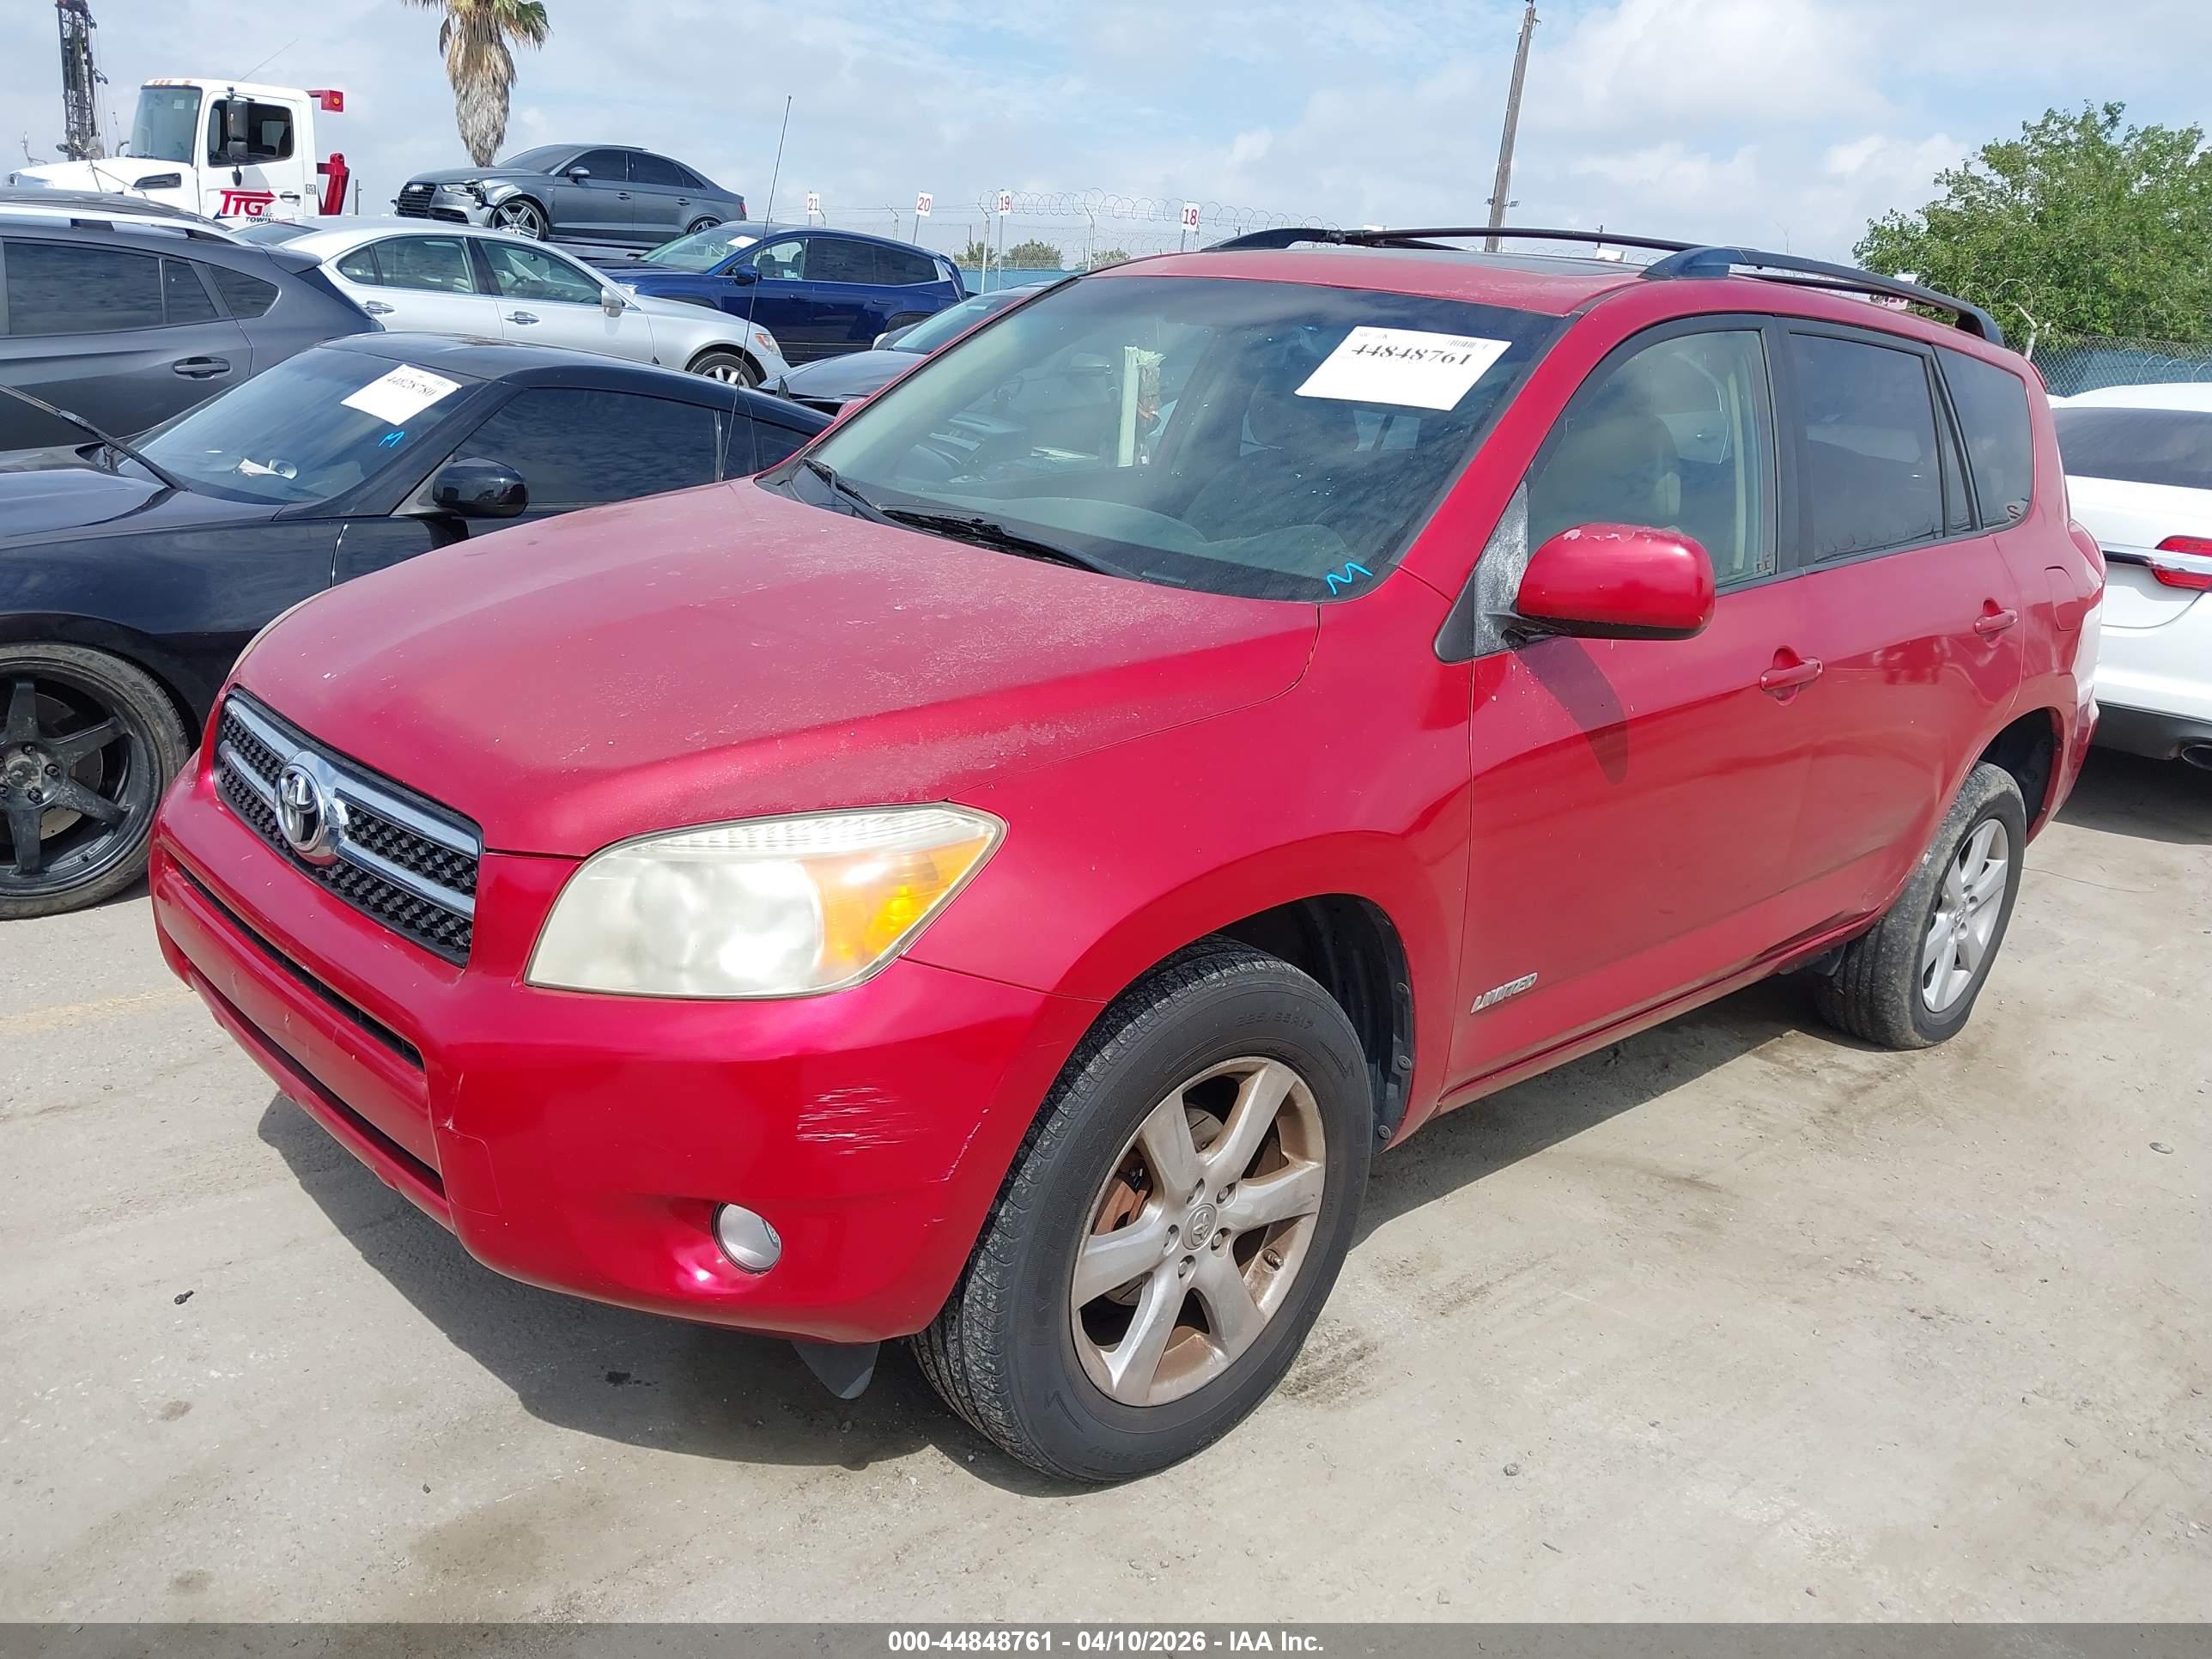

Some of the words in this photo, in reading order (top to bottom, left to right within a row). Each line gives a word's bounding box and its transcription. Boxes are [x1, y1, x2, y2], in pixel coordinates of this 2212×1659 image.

[220, 190, 276, 216] TTG
[808, 198, 818, 211] 21
[917, 197, 931, 212] 20
[1000, 195, 1011, 211] 19
[1182, 209, 1198, 226] 18
[1351, 343, 1473, 366] 44848761
